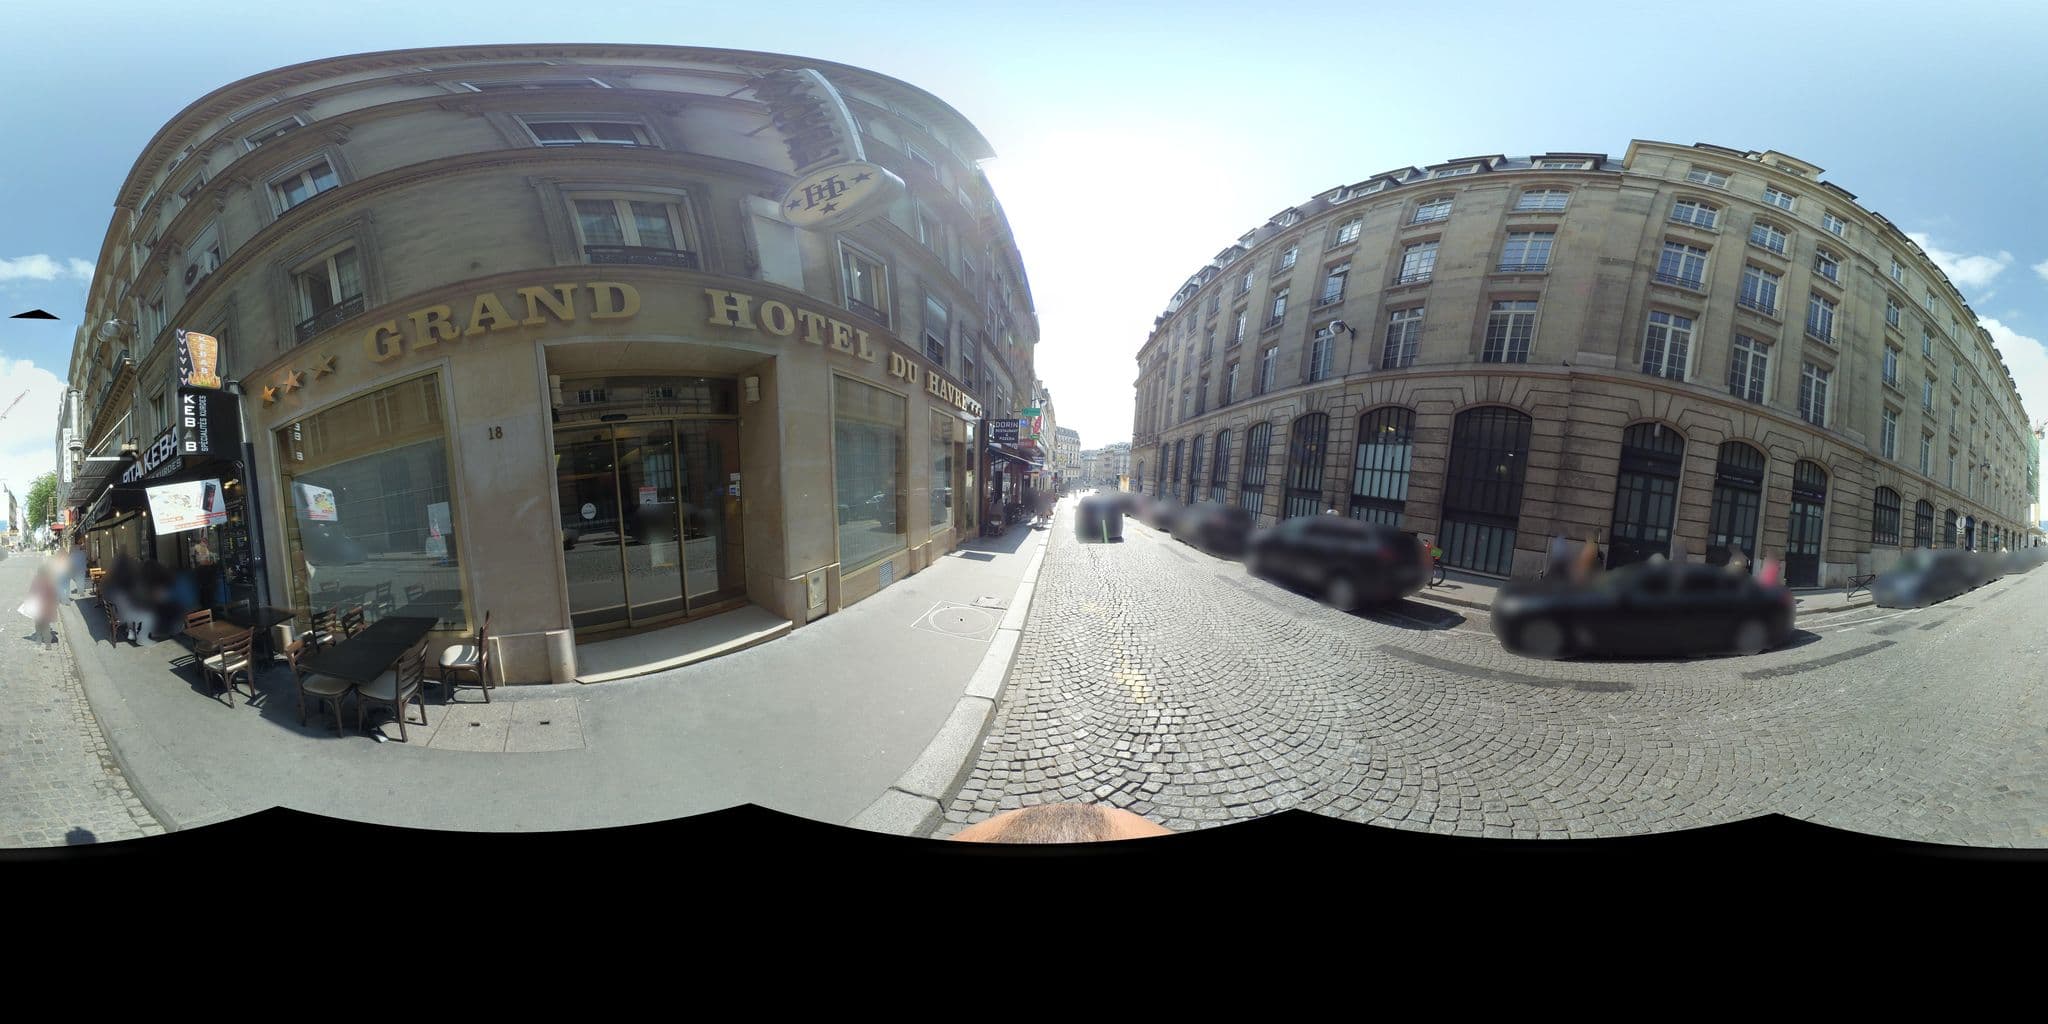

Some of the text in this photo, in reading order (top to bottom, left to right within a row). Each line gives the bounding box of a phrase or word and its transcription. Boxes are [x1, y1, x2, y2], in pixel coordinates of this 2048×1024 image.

[363, 281, 967, 411] GRAND HOTEL DU HAVRE
[488, 425, 503, 440] 18
